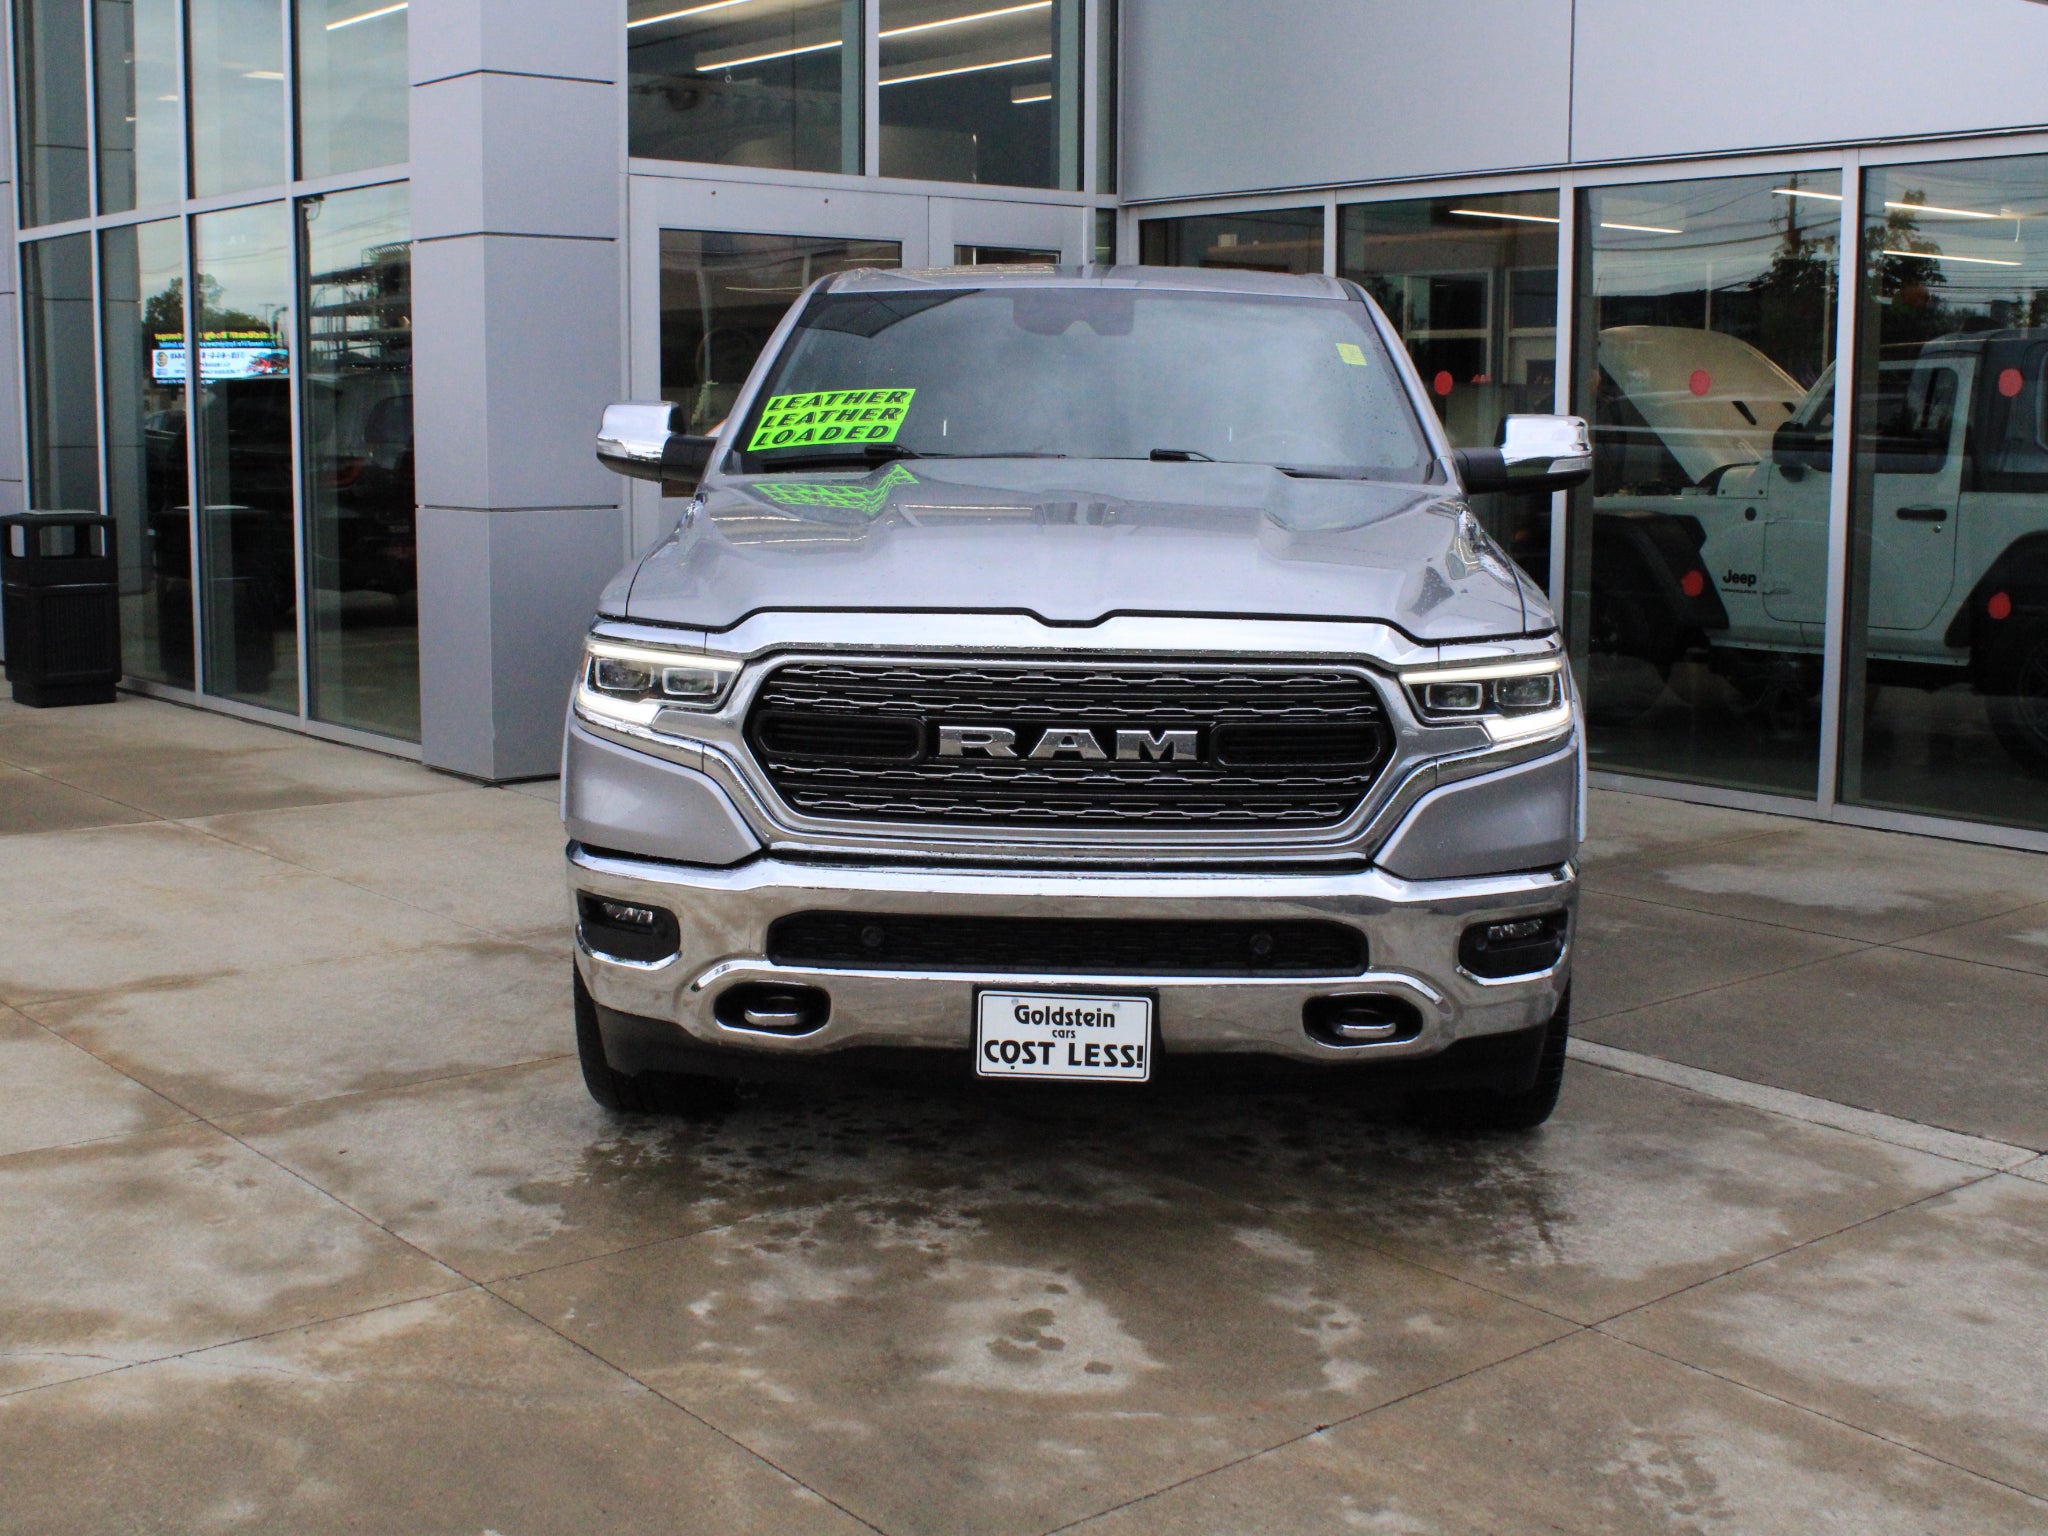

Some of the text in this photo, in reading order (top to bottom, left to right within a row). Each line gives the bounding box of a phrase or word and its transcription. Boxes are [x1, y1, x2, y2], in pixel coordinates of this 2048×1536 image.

[768, 391, 909, 411] LEATHER
[761, 407, 903, 429] LEATHER
[753, 425, 892, 447] LOADED
[1722, 569, 1757, 587] Jeep
[939, 725, 1198, 761] RAM
[1014, 1005, 1116, 1028] Goldstein
[1051, 1029, 1077, 1039] cars
[984, 1039, 1144, 1069] COST LESS!
